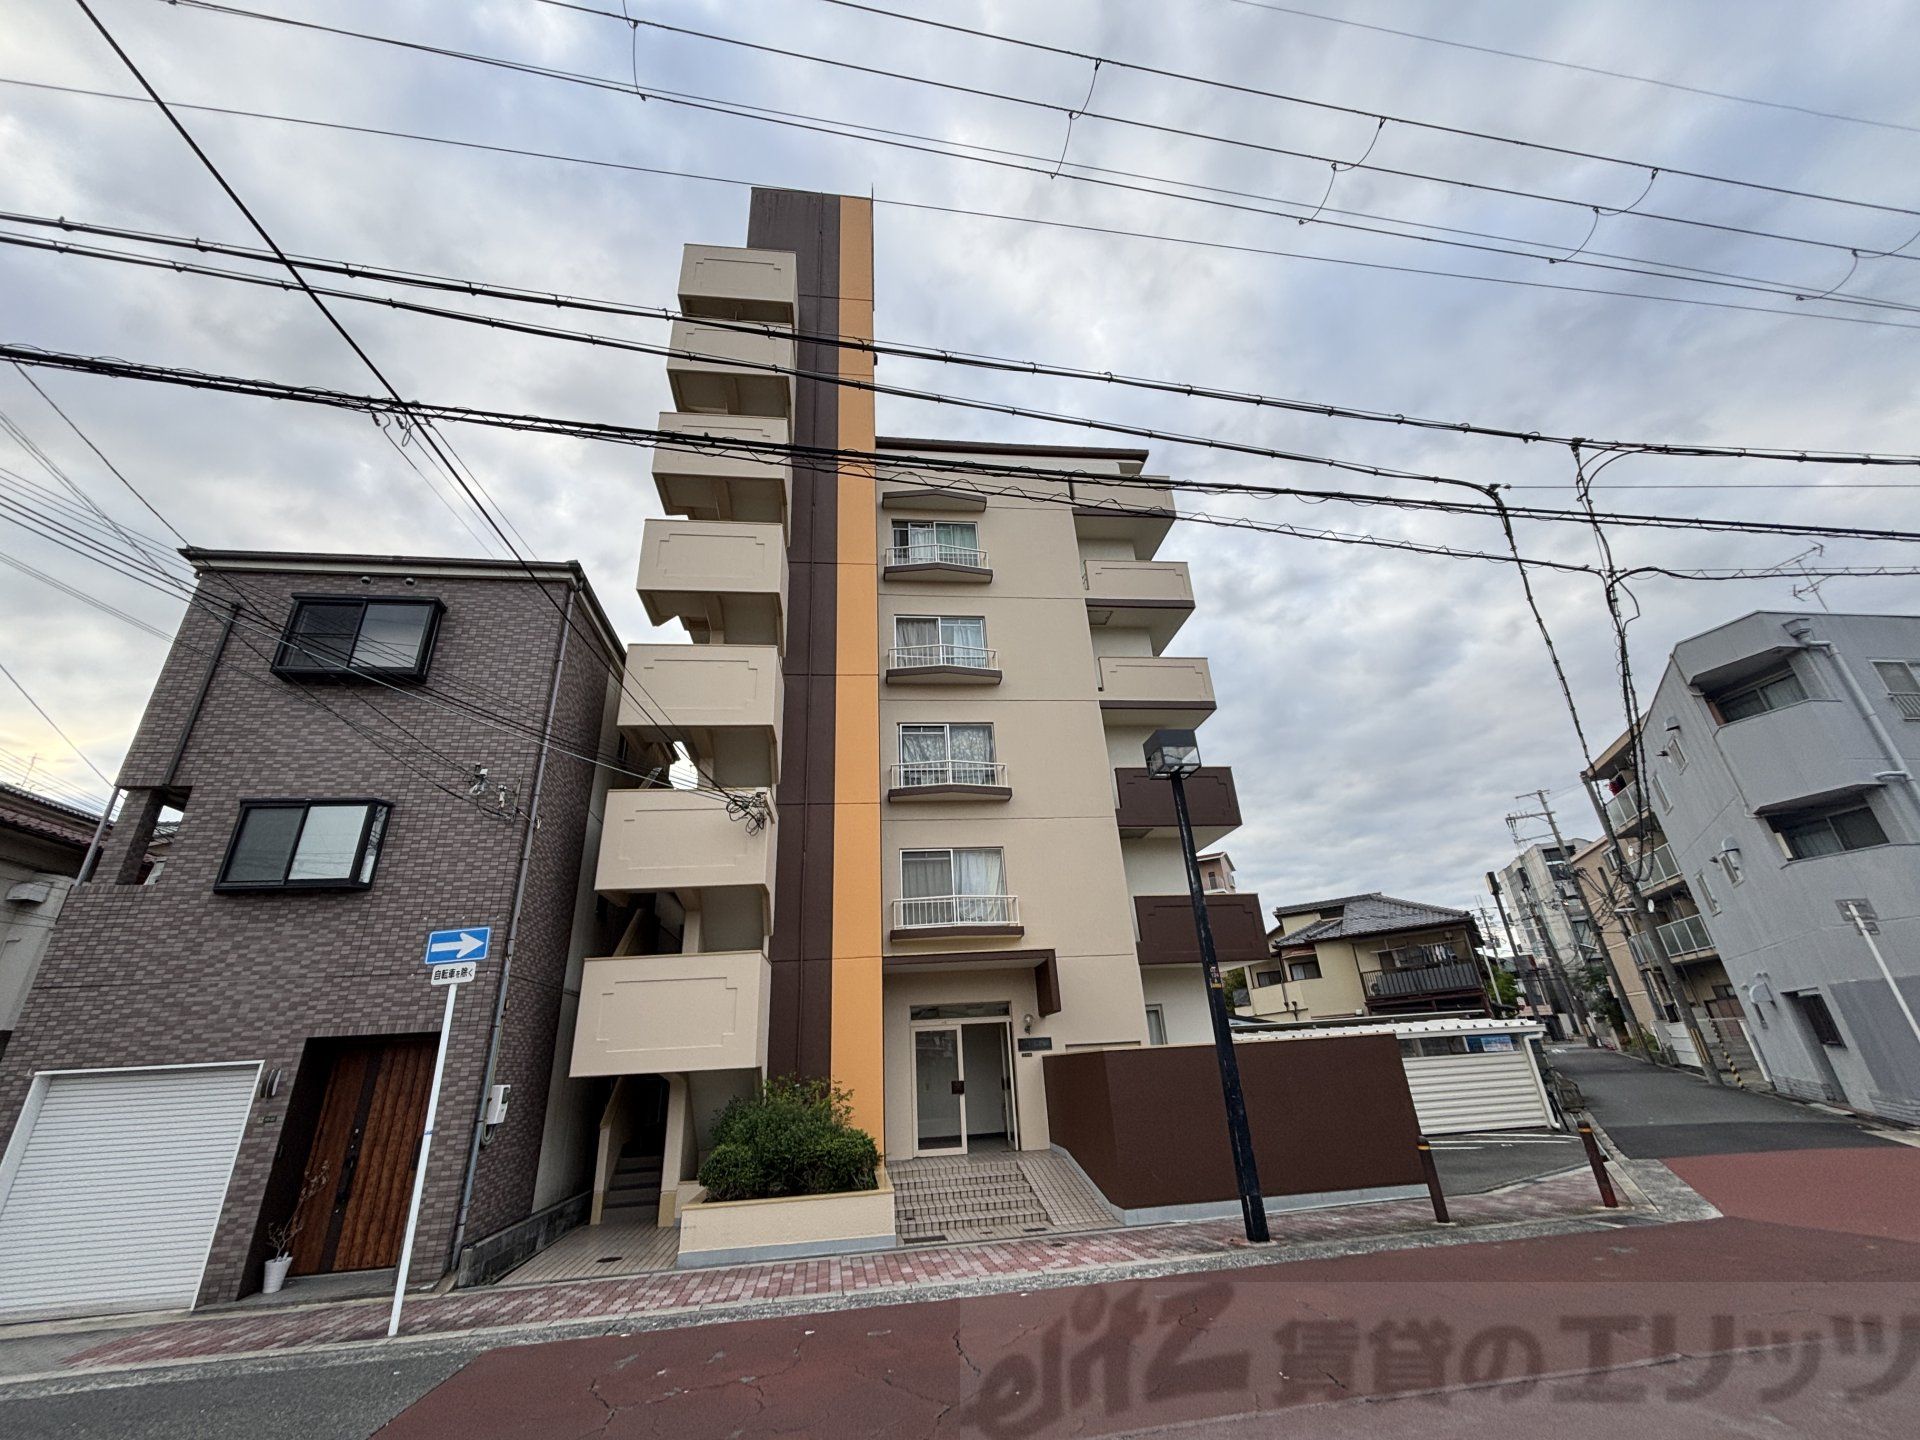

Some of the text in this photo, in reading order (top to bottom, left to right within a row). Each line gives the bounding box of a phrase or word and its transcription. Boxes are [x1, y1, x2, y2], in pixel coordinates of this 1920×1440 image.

[434, 966, 473, 981] 自転車を除く
